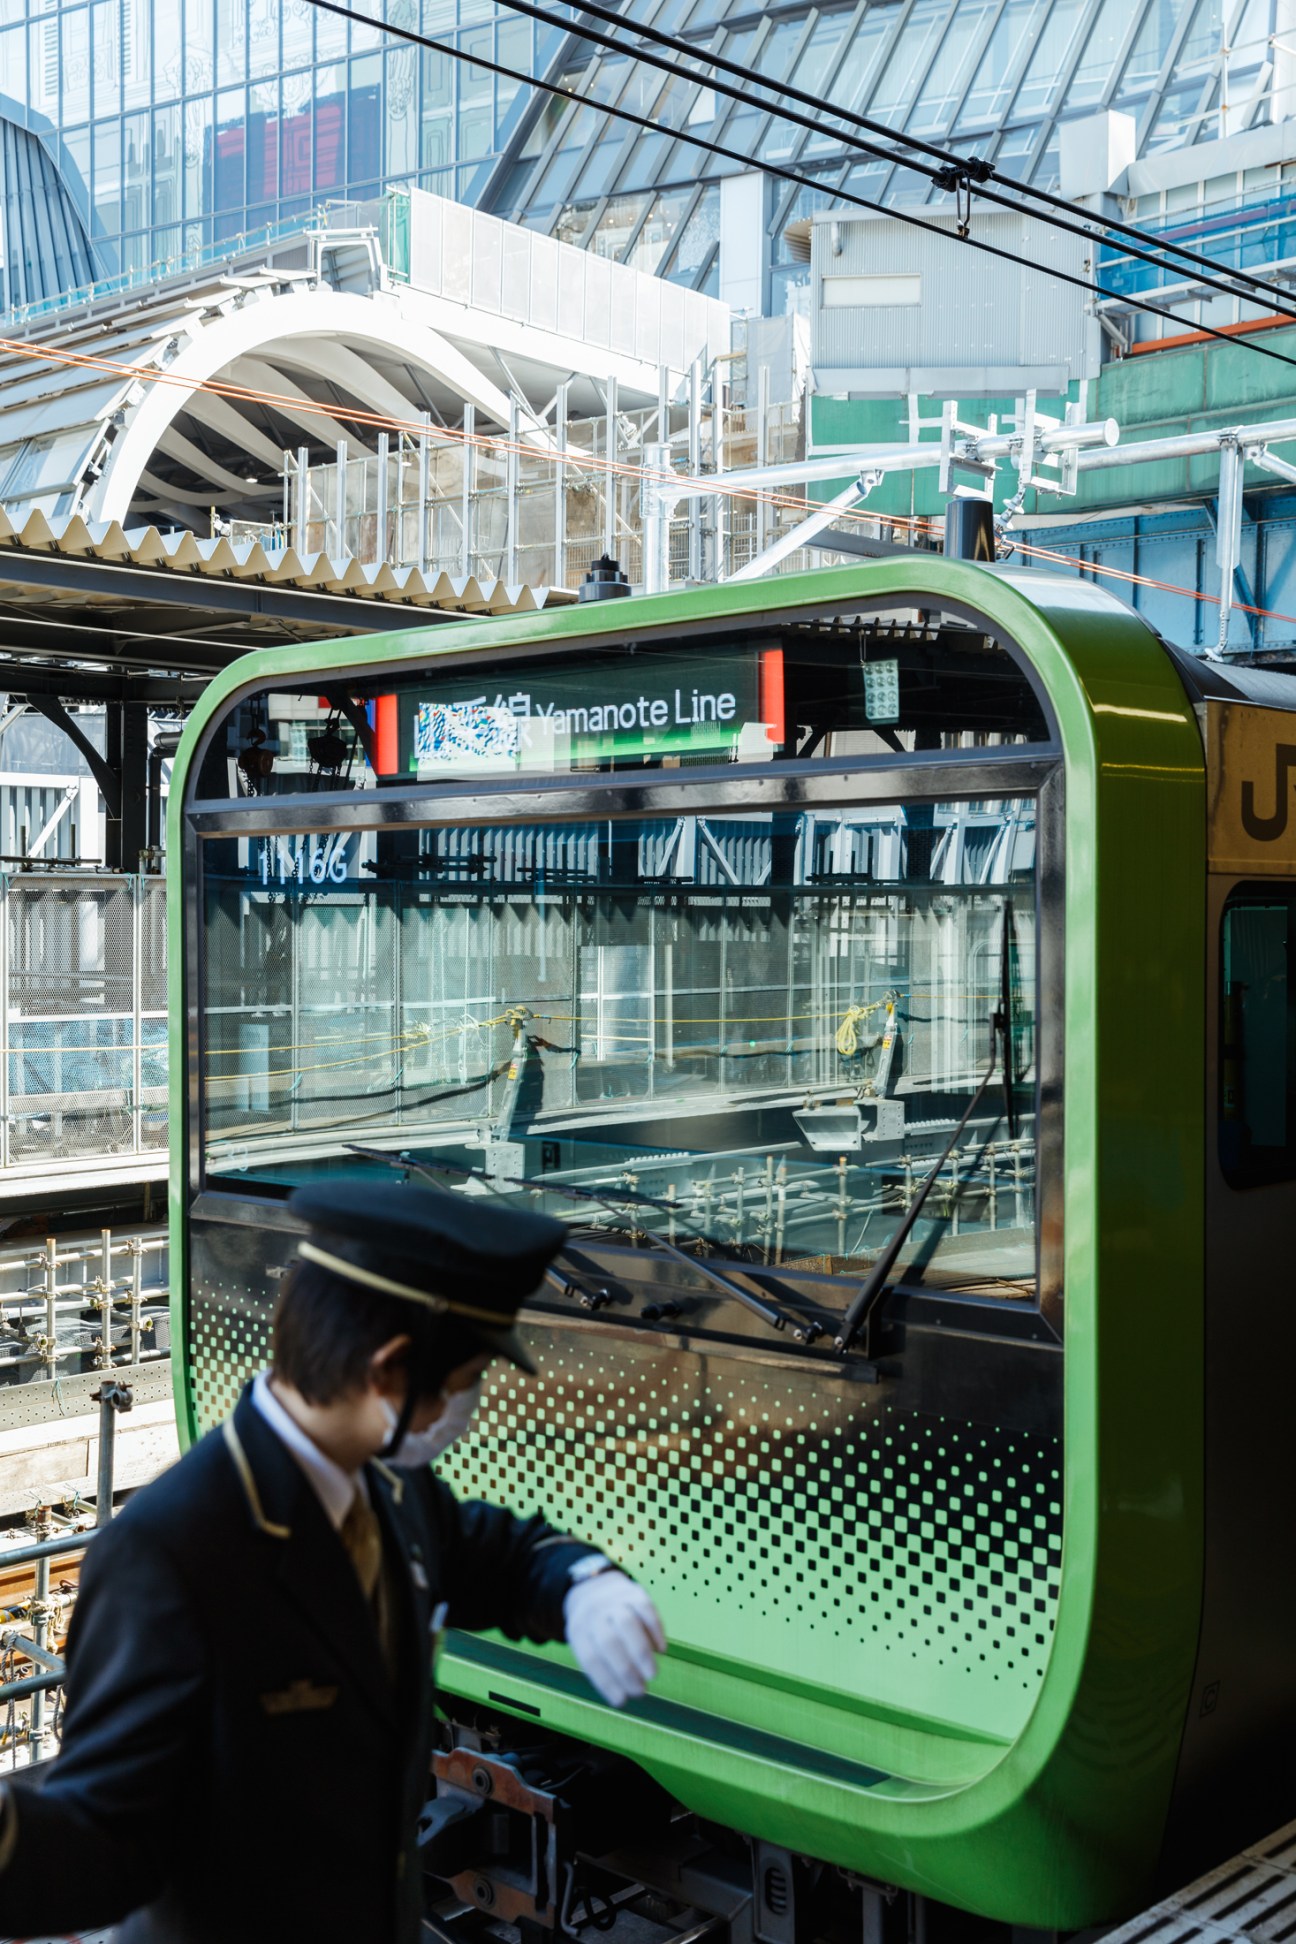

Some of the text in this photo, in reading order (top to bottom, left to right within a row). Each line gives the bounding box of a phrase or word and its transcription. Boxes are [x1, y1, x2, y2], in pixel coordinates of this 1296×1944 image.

[535, 696, 669, 736] Yamanote
[674, 688, 736, 724] Line
[1241, 743, 1296, 842] J
[260, 848, 347, 885] 1116G
